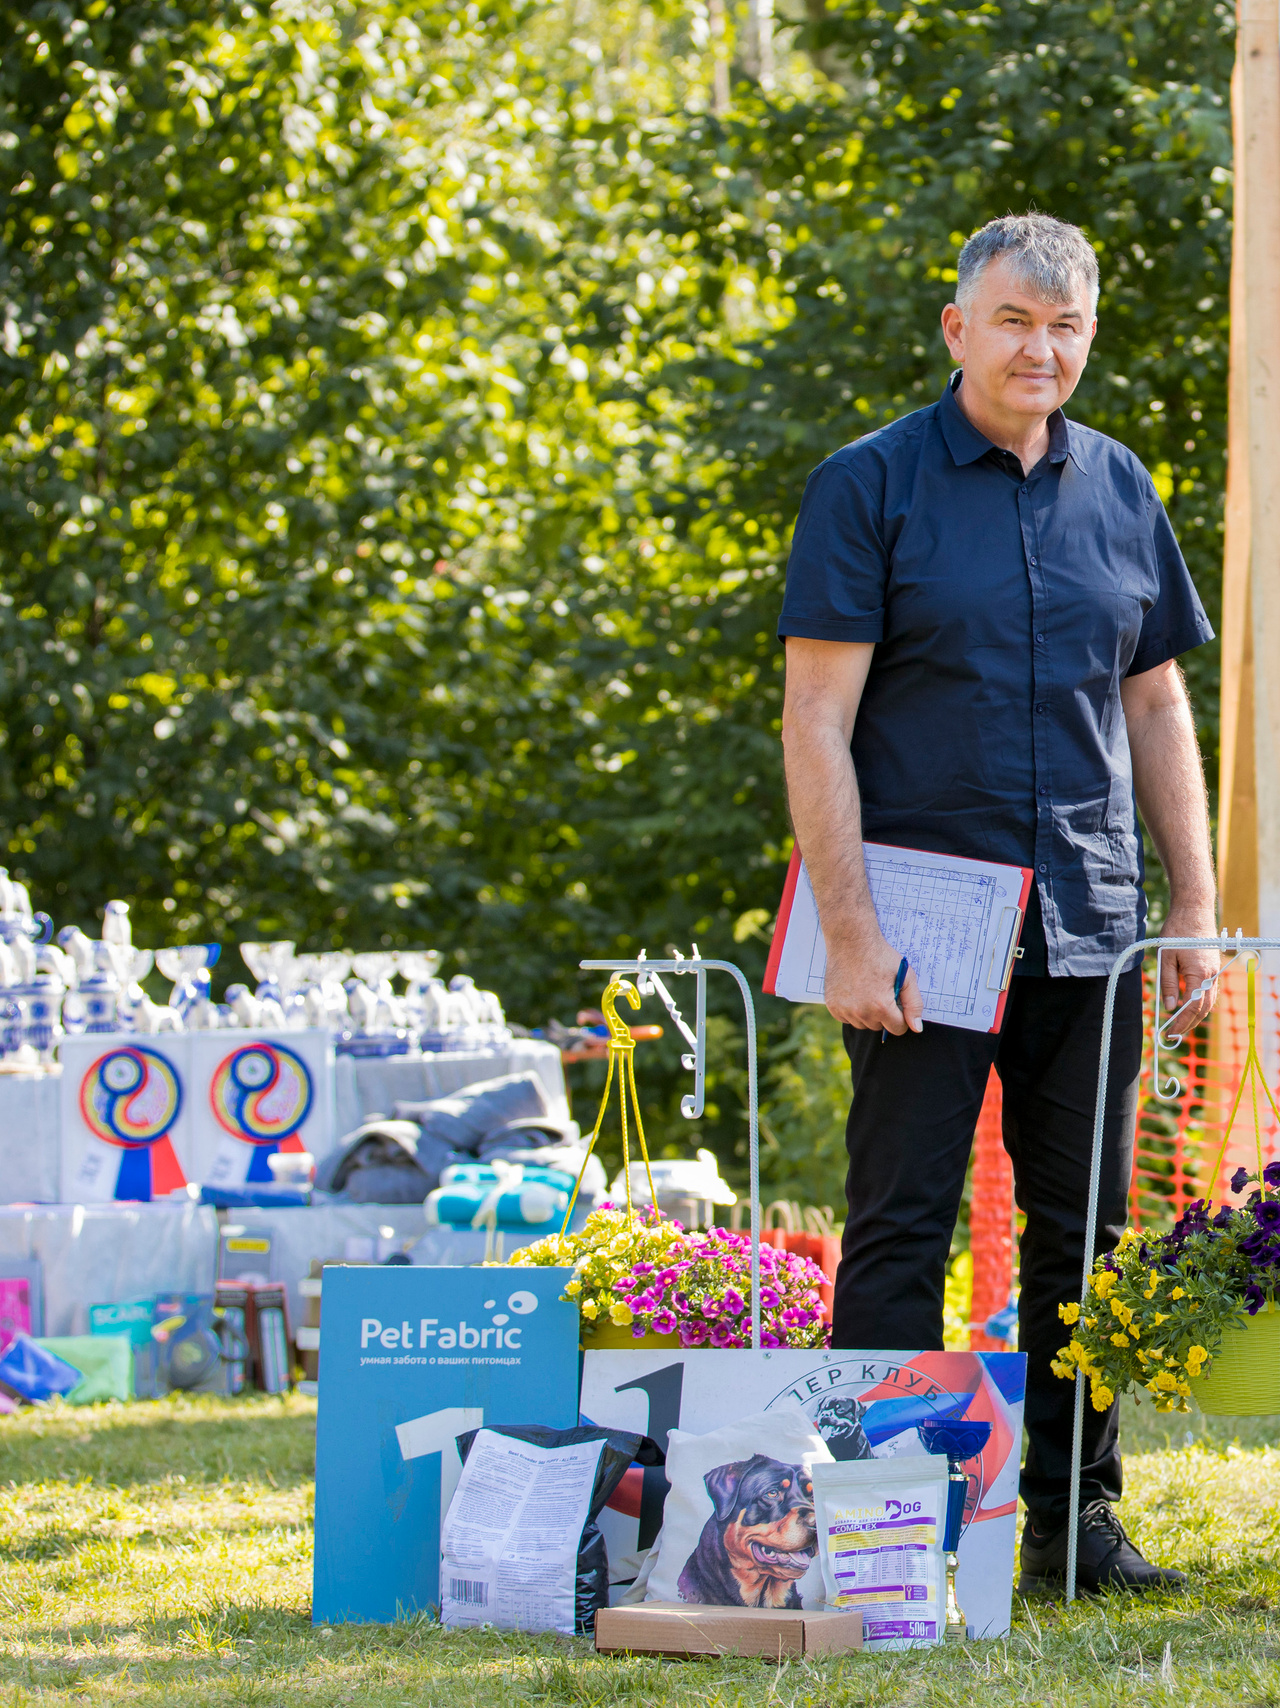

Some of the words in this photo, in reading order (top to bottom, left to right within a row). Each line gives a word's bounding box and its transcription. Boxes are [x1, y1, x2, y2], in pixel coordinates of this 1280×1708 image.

[361, 1318, 413, 1349] Pet
[420, 1318, 522, 1349] Fabric
[360, 1356, 391, 1366] умная
[393, 1355, 427, 1365] забота
[429, 1357, 436, 1365] о
[438, 1357, 470, 1365] ваших
[472, 1357, 521, 1366] питомцах
[862, 1364, 939, 1402] КЛУБ
[835, 1506, 884, 1520] AMINO
[835, 1522, 877, 1534] COMPLEX
